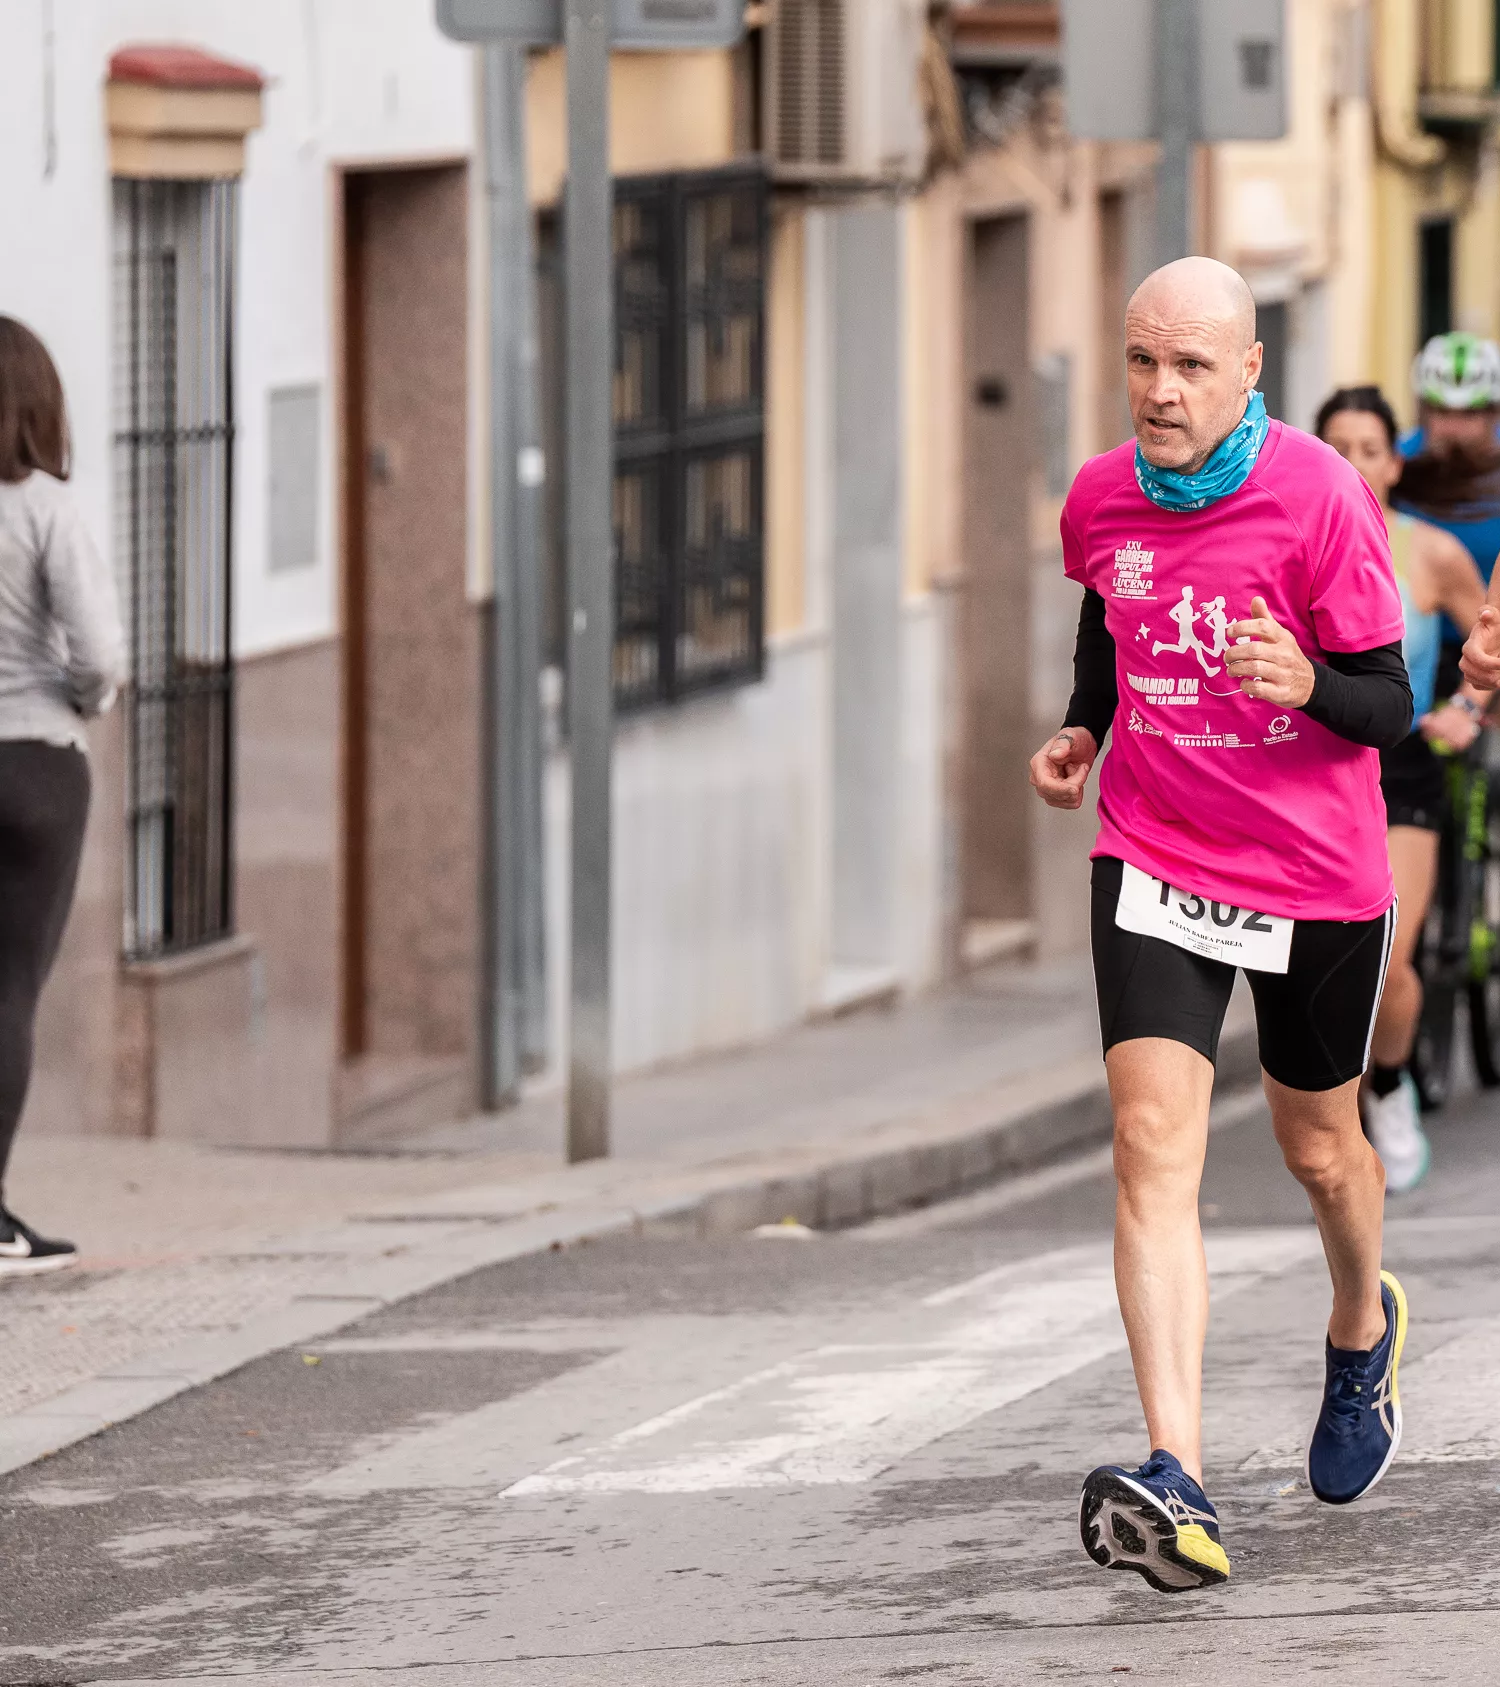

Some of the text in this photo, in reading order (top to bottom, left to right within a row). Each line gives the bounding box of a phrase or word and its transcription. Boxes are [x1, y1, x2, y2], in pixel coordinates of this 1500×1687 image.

[1126, 541, 1142, 550] XXV
[1115, 549, 1155, 564] CARRERA
[1114, 562, 1153, 572] POPULAR
[1112, 577, 1153, 589] LUCENA
[1177, 678, 1199, 695] KM
[1145, 695, 1199, 705] POR LA IGUALDAD
[1168, 919, 1191, 933] JULIAN
[1215, 938, 1243, 948] PAREJA
